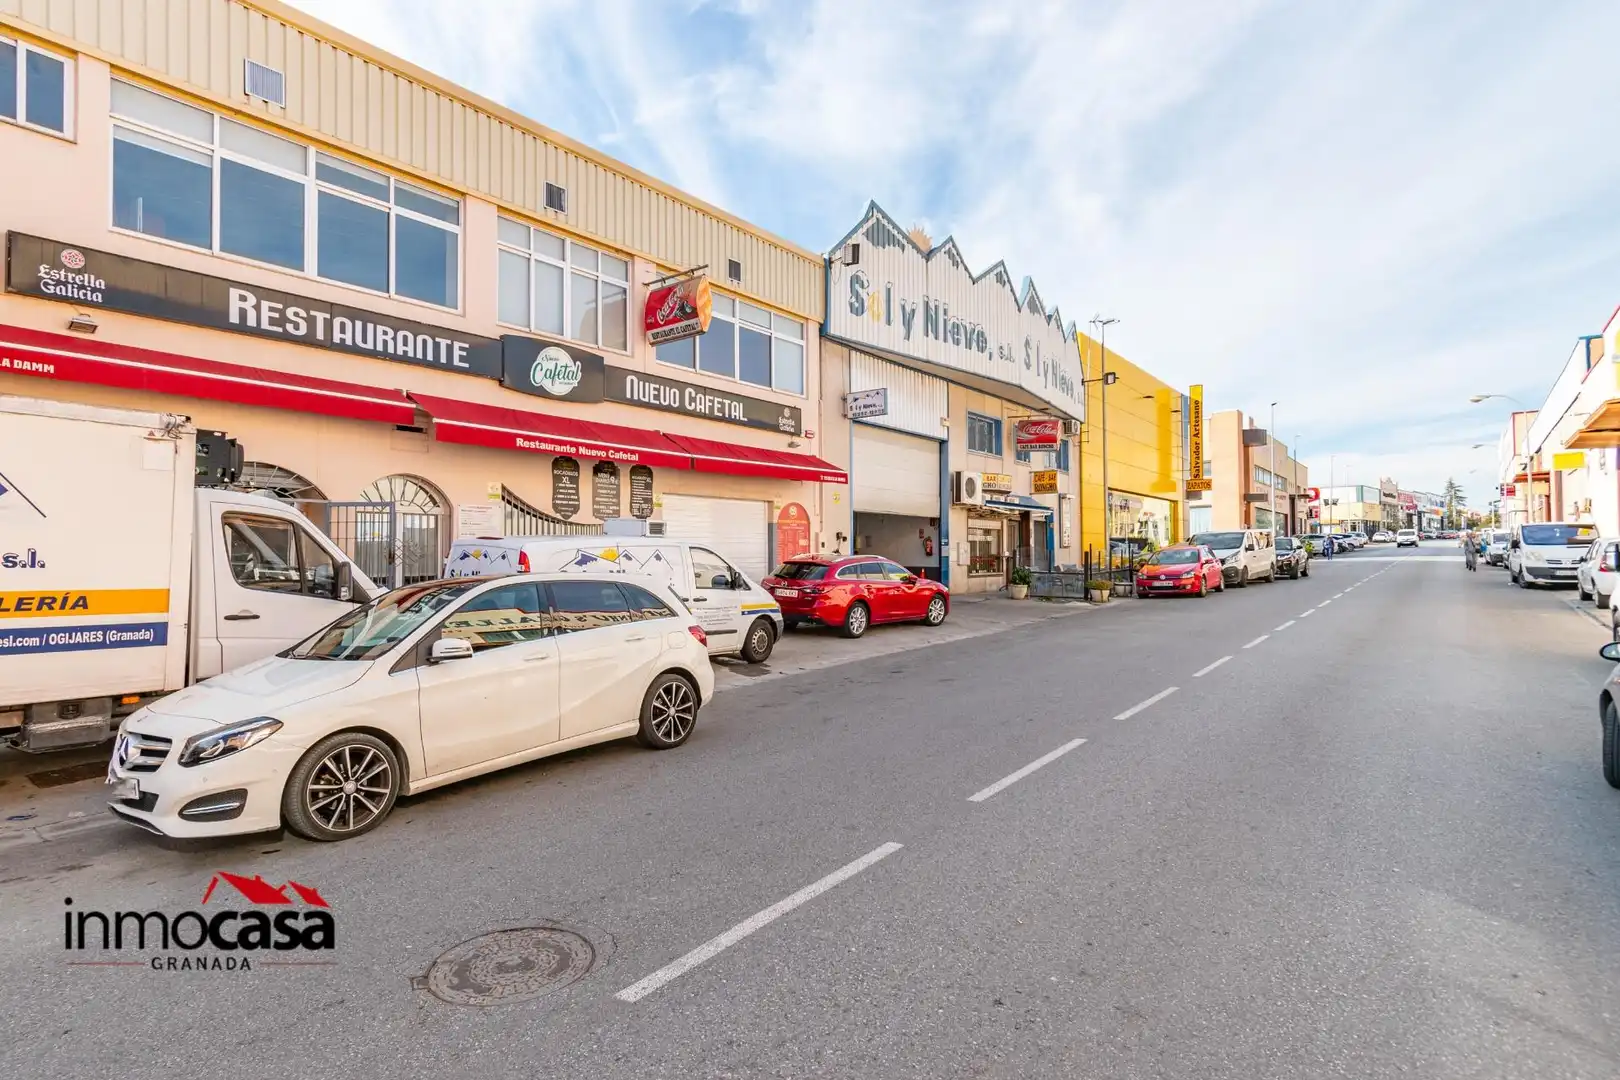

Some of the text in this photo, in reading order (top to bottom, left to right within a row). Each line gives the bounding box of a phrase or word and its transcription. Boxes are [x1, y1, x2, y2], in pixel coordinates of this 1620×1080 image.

[37, 264, 106, 290] Estrella
[40, 277, 103, 303] Galicia
[13, 359, 55, 374] DAMM
[532, 361, 580, 386] Cafetal
[1193, 400, 1201, 438] Artesano
[516, 438, 639, 461] Restaurante Nuevo Cafetal
[1193, 442, 1201, 479] Salvador
[562, 476, 570, 484] XL
[1187, 481, 1211, 490] ZAPATOS
[1, 548, 46, 569] s.l.
[49, 629, 103, 645] OGIJARES
[106, 628, 154, 644] (Granada)
